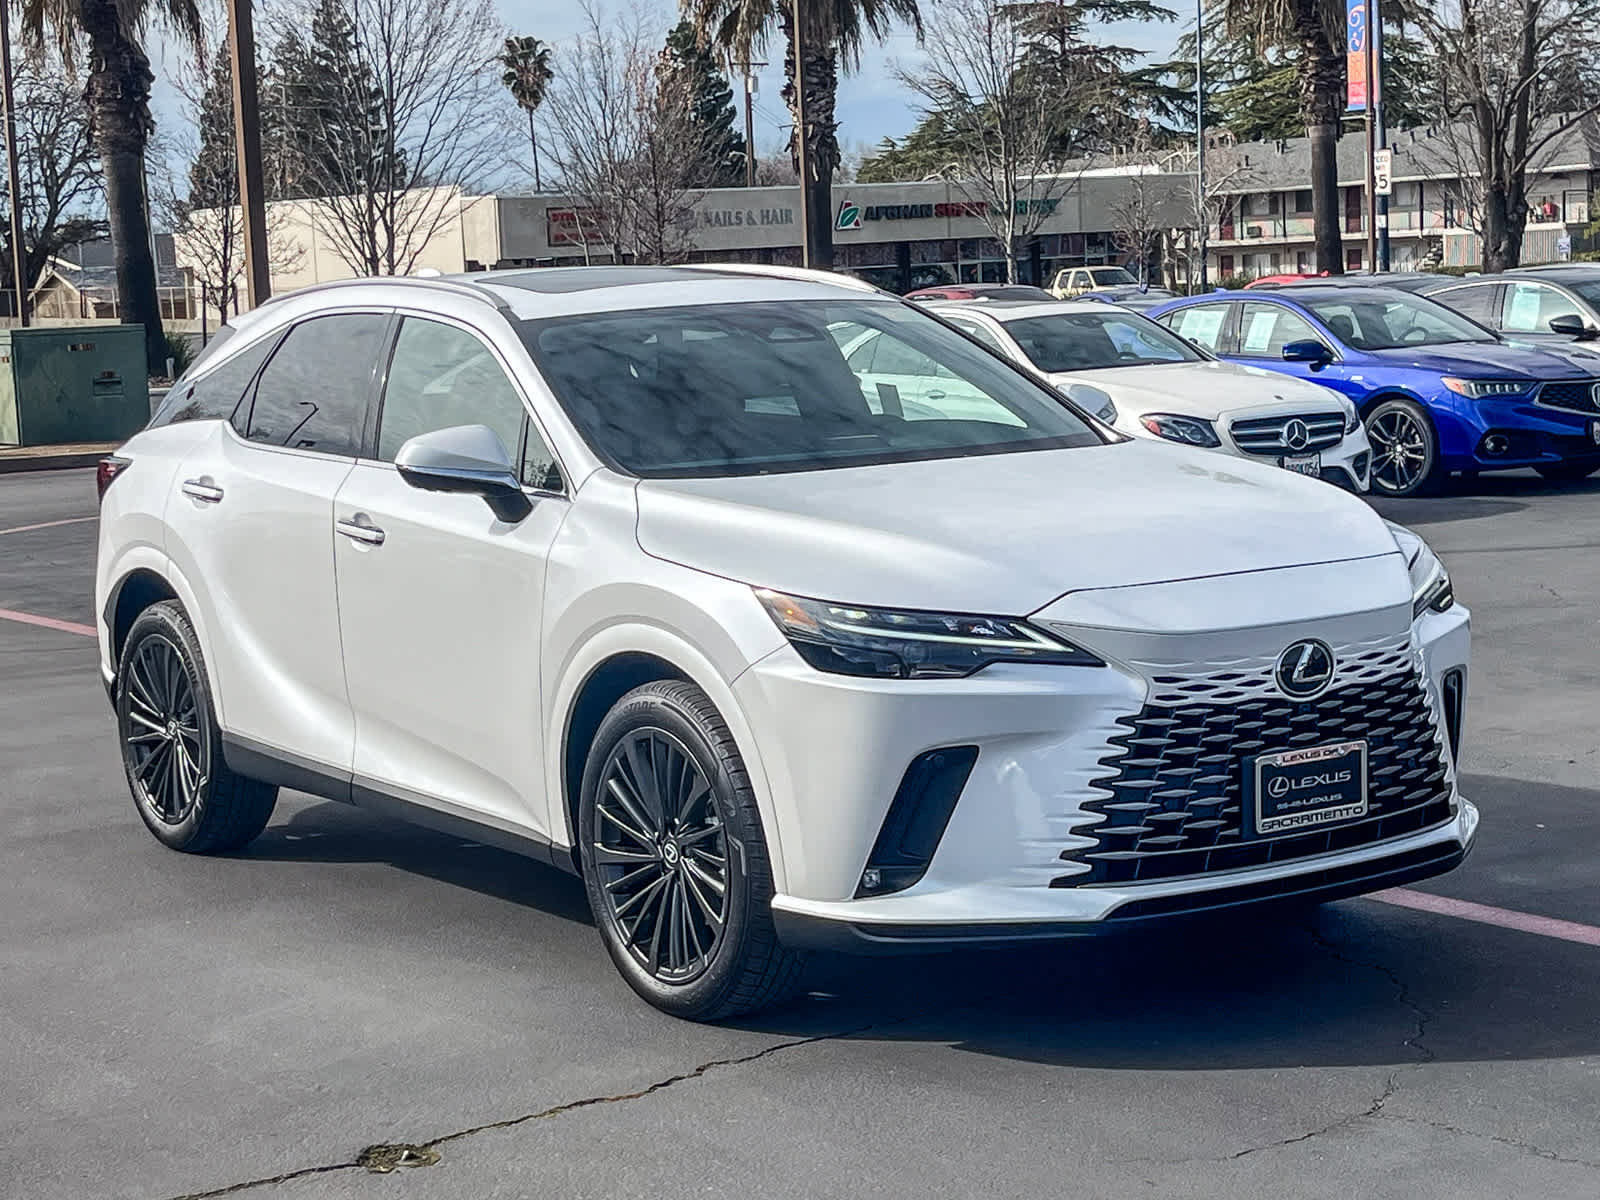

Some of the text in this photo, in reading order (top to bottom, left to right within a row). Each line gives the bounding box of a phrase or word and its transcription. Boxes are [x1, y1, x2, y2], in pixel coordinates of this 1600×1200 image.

[746, 209, 759, 226] &
[760, 208, 793, 225] HAIR
[864, 204, 933, 221] AFGHAN
[1282, 750, 1320, 763] LEXUS
[1291, 770, 1352, 790] LEXUS
[1261, 806, 1363, 830] SACRAMENTO
